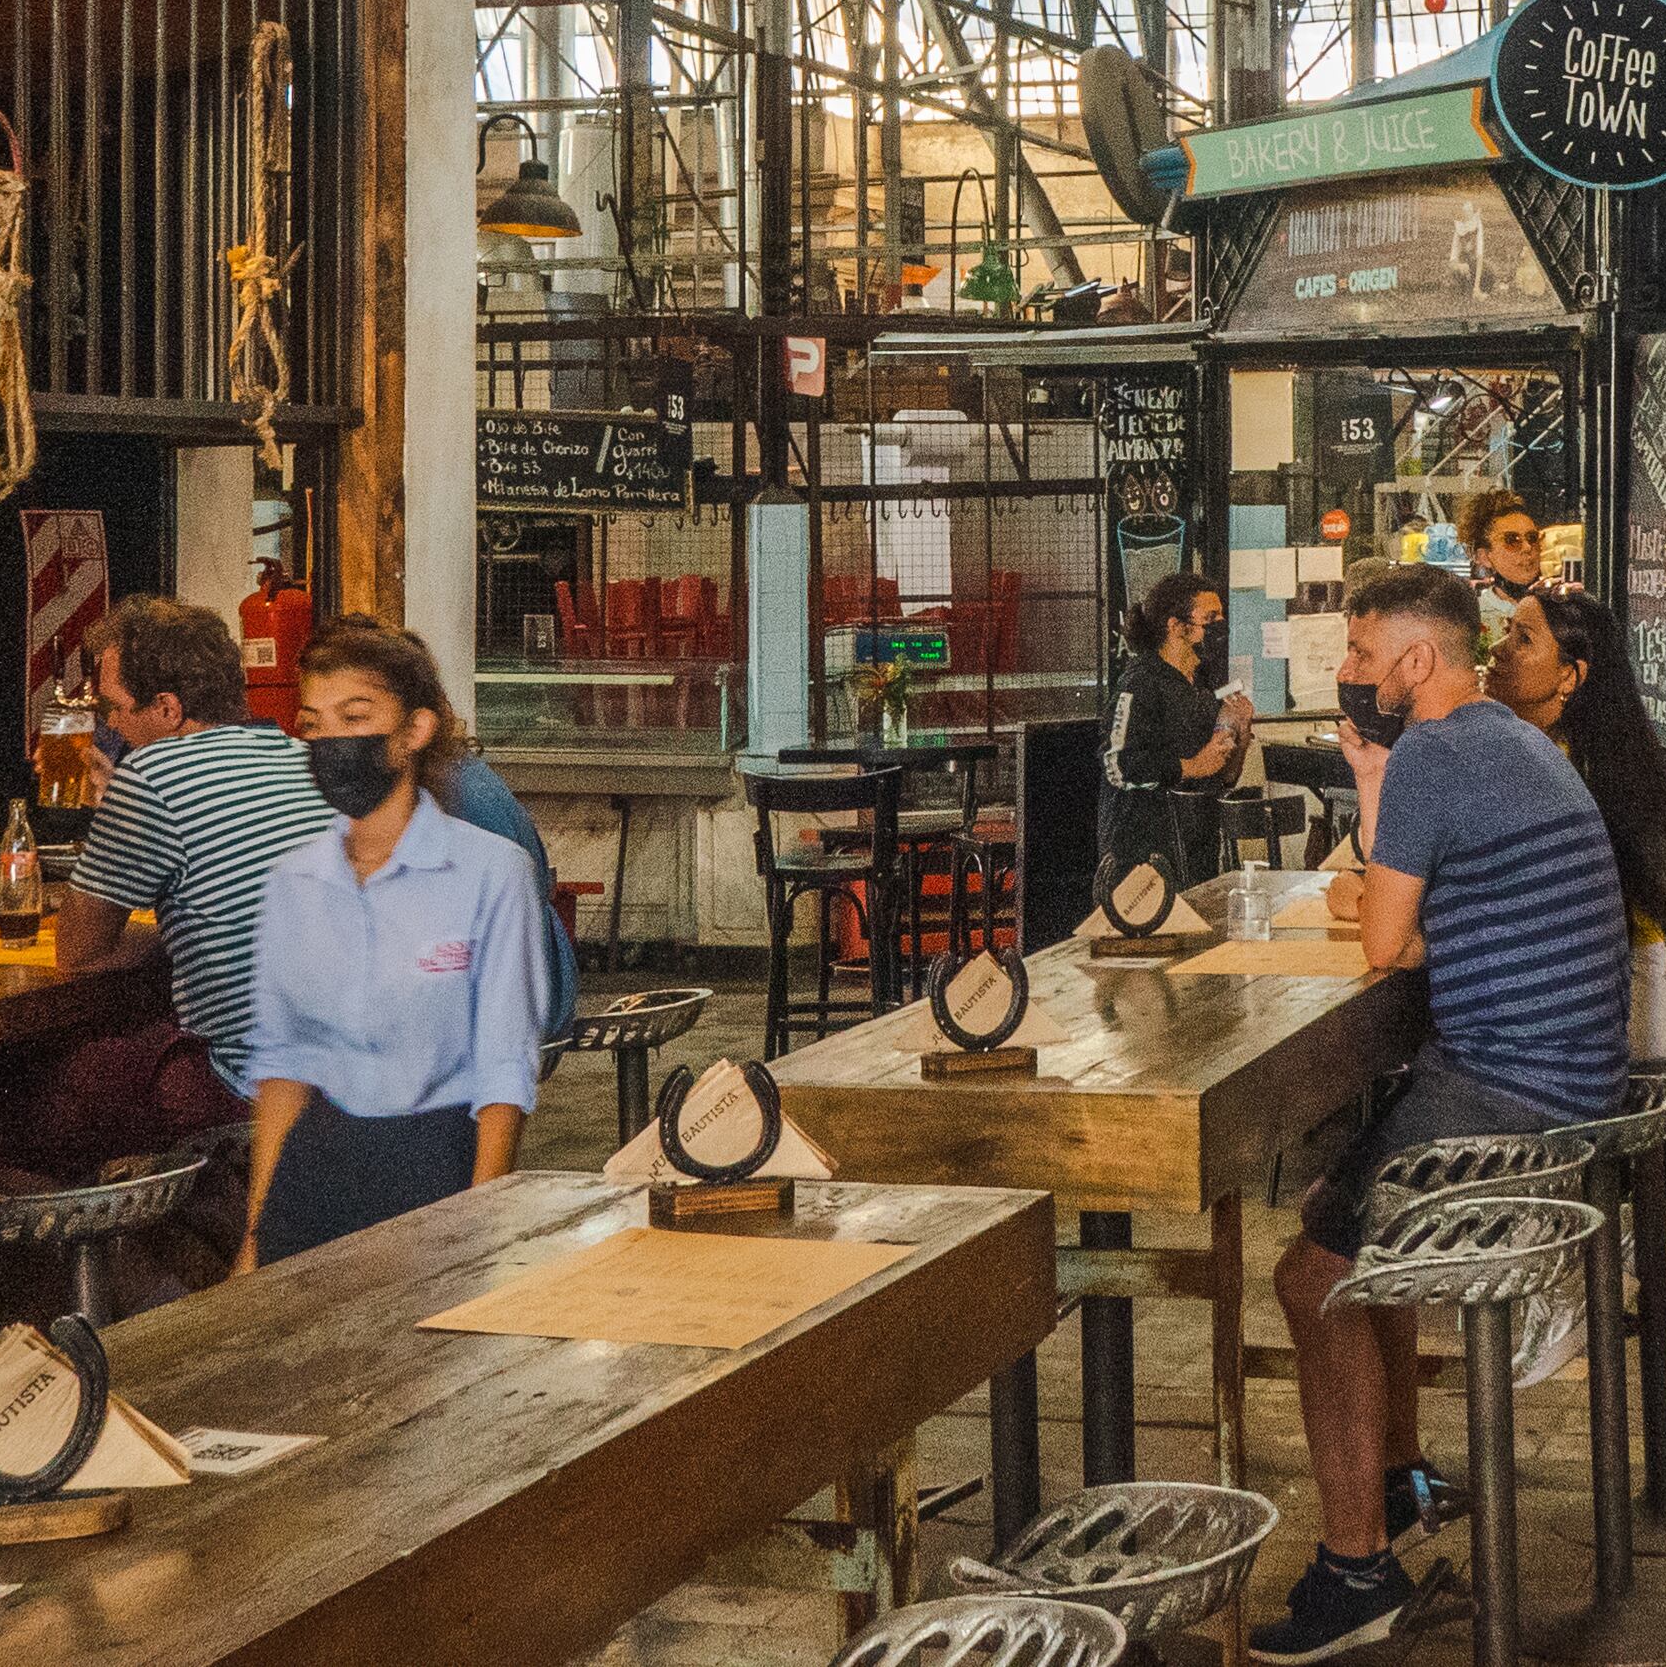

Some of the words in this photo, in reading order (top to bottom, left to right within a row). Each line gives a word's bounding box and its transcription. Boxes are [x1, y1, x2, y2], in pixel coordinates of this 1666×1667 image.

[1228, 122, 1322, 178] BAKERY
[1355, 107, 1436, 166] JUICE
[1348, 416, 1376, 440] 53
[953, 973, 997, 1021] BAUTISTA
[680, 1091, 739, 1144] BAUTISTA
